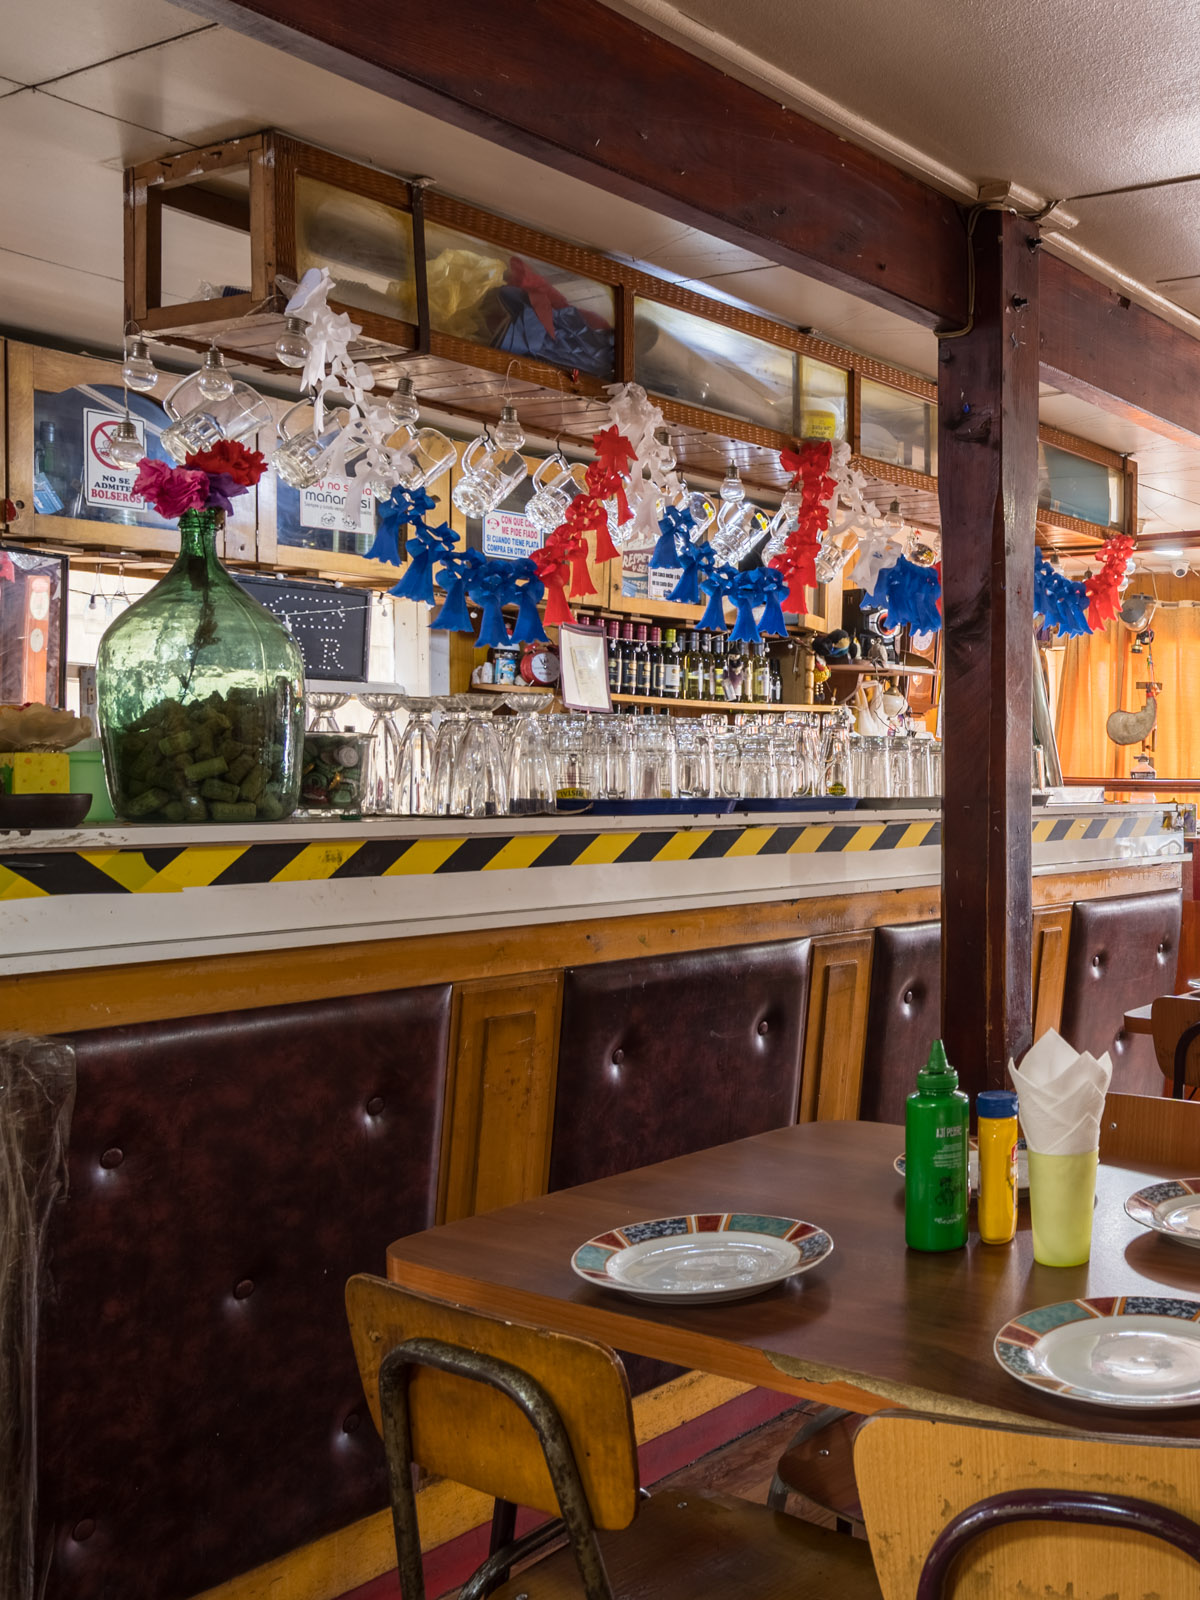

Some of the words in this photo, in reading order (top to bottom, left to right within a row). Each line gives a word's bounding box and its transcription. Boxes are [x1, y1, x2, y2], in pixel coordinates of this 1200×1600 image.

[102, 475, 116, 483] NO
[94, 482, 132, 492] ADMITE
[328, 482, 340, 490] no
[306, 491, 346, 504] mañan
[501, 516, 512, 524] CON
[513, 517, 524, 527] QUE
[502, 527, 509, 535] ME
[510, 528, 522, 538] PIDE
[523, 530, 537, 539] FIADO
[493, 535, 511, 545] CUANDO
[512, 538, 524, 547] TIENE
[526, 540, 539, 548] PLATA
[487, 544, 506, 553] COMPRA
[507, 546, 513, 554] EN
[514, 548, 526, 556] OTRO
[623, 553, 652, 567] RESPET
